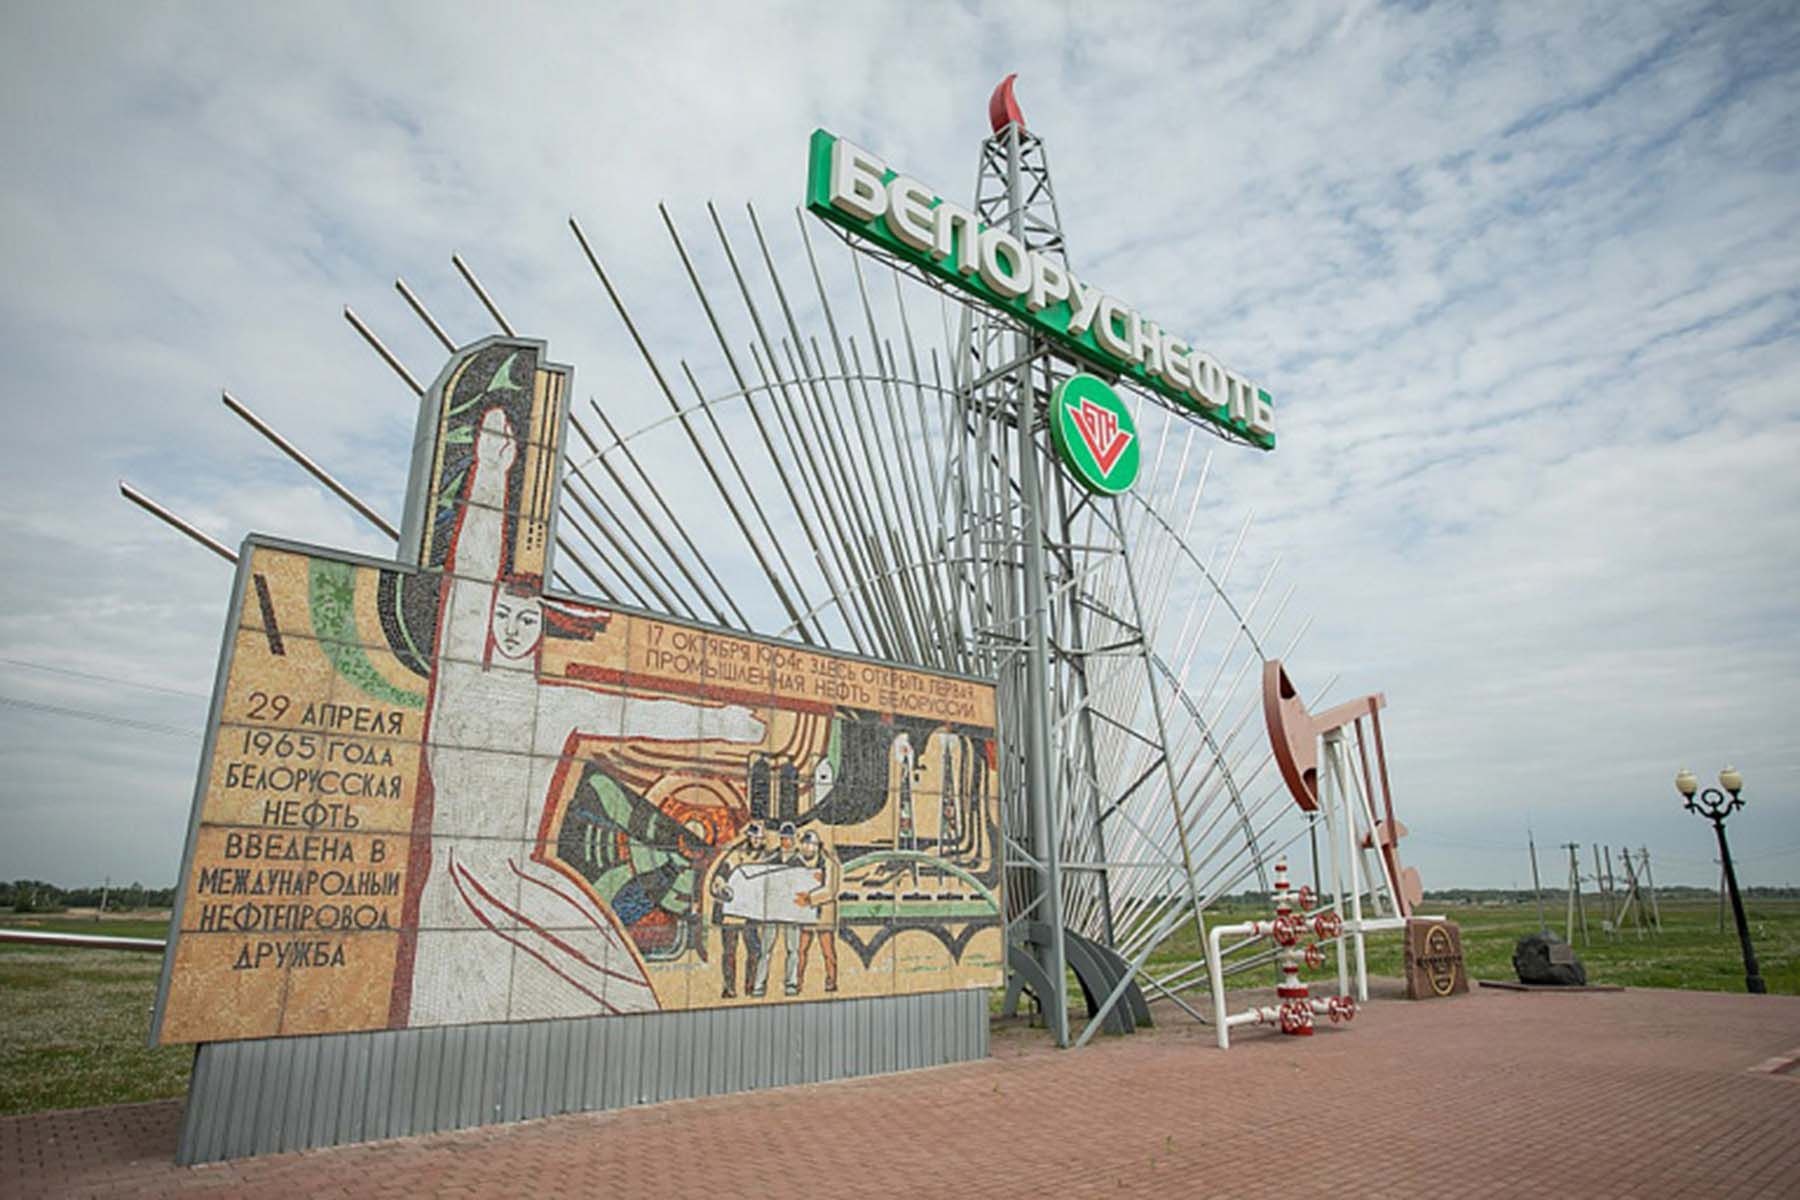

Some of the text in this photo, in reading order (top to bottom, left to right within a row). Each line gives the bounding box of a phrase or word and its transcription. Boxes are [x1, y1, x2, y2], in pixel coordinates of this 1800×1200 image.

[648, 623, 664, 647] 17
[672, 632, 750, 662] ОКТЯБРЯ
[810, 657, 856, 681] ЗДЕСЬ
[645, 648, 976, 718] ПРОМЫШЛЕННАЯ НЕФТЬ БЕЛОРУССИИ
[246, 691, 404, 735] 29 АПРЕЛЯ
[242, 730, 394, 767] 1965 ГОДА
[225, 763, 402, 799] БЕЛОРУССКАЯ
[262, 799, 360, 830] НЕФТЬ
[224, 833, 386, 863] ВВЕДЕНА В
[200, 901, 392, 931] НЕФТЕПРОВОД
[232, 941, 346, 970] ДРУЖБА
